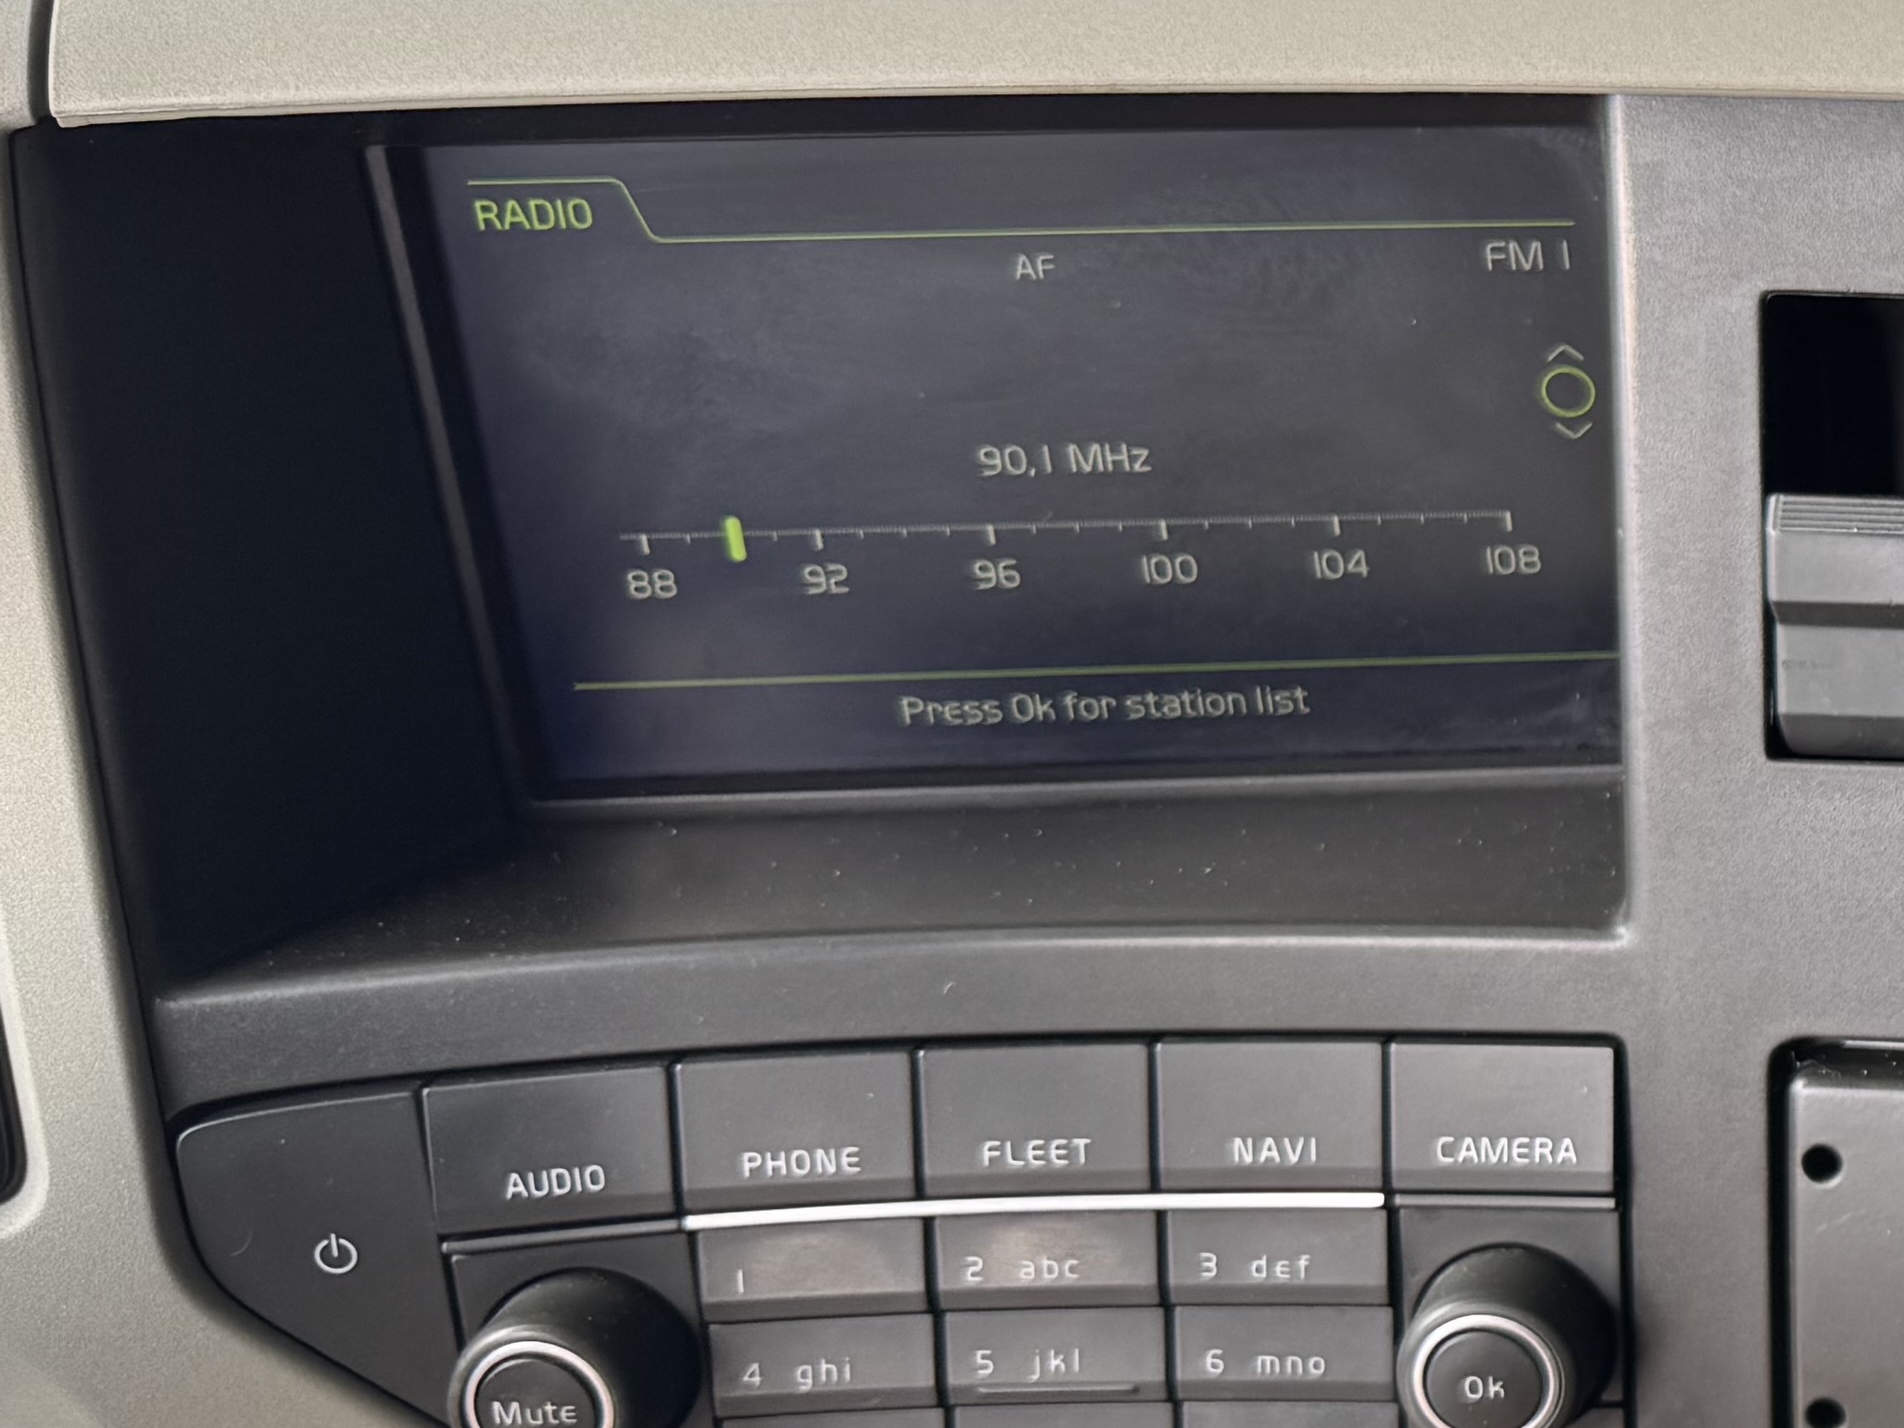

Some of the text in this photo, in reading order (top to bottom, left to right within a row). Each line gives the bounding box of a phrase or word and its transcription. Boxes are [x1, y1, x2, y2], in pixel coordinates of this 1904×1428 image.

[474, 199, 593, 231] RADIO
[1014, 254, 1056, 280] AF
[1485, 242, 1544, 271] FM
[978, 443, 1152, 477] 90,1 MHz
[973, 559, 1021, 590] 96
[1141, 555, 1197, 584] 100
[1313, 550, 1369, 579] 104
[1486, 546, 1541, 574] 108
[626, 570, 677, 600] 88
[802, 565, 849, 594] 92
[900, 687, 1310, 726] Press Ok for station list
[741, 1147, 861, 1178] PHONE
[981, 1139, 1091, 1168] FLEET
[1232, 1137, 1317, 1164] NAVI
[1436, 1137, 1577, 1165] CAMERA
[505, 1165, 606, 1200] AUDIO
[964, 1255, 1080, 1283] 2 abc
[1200, 1254, 1311, 1280] 3 def
[736, 1269, 745, 1295] 1
[742, 1357, 851, 1391] 4 ghi
[975, 1348, 1080, 1381] 5 jkl
[1204, 1349, 1326, 1377] 6 mno
[1463, 1376, 1505, 1401] Ok
[491, 1400, 577, 1426] Mute
